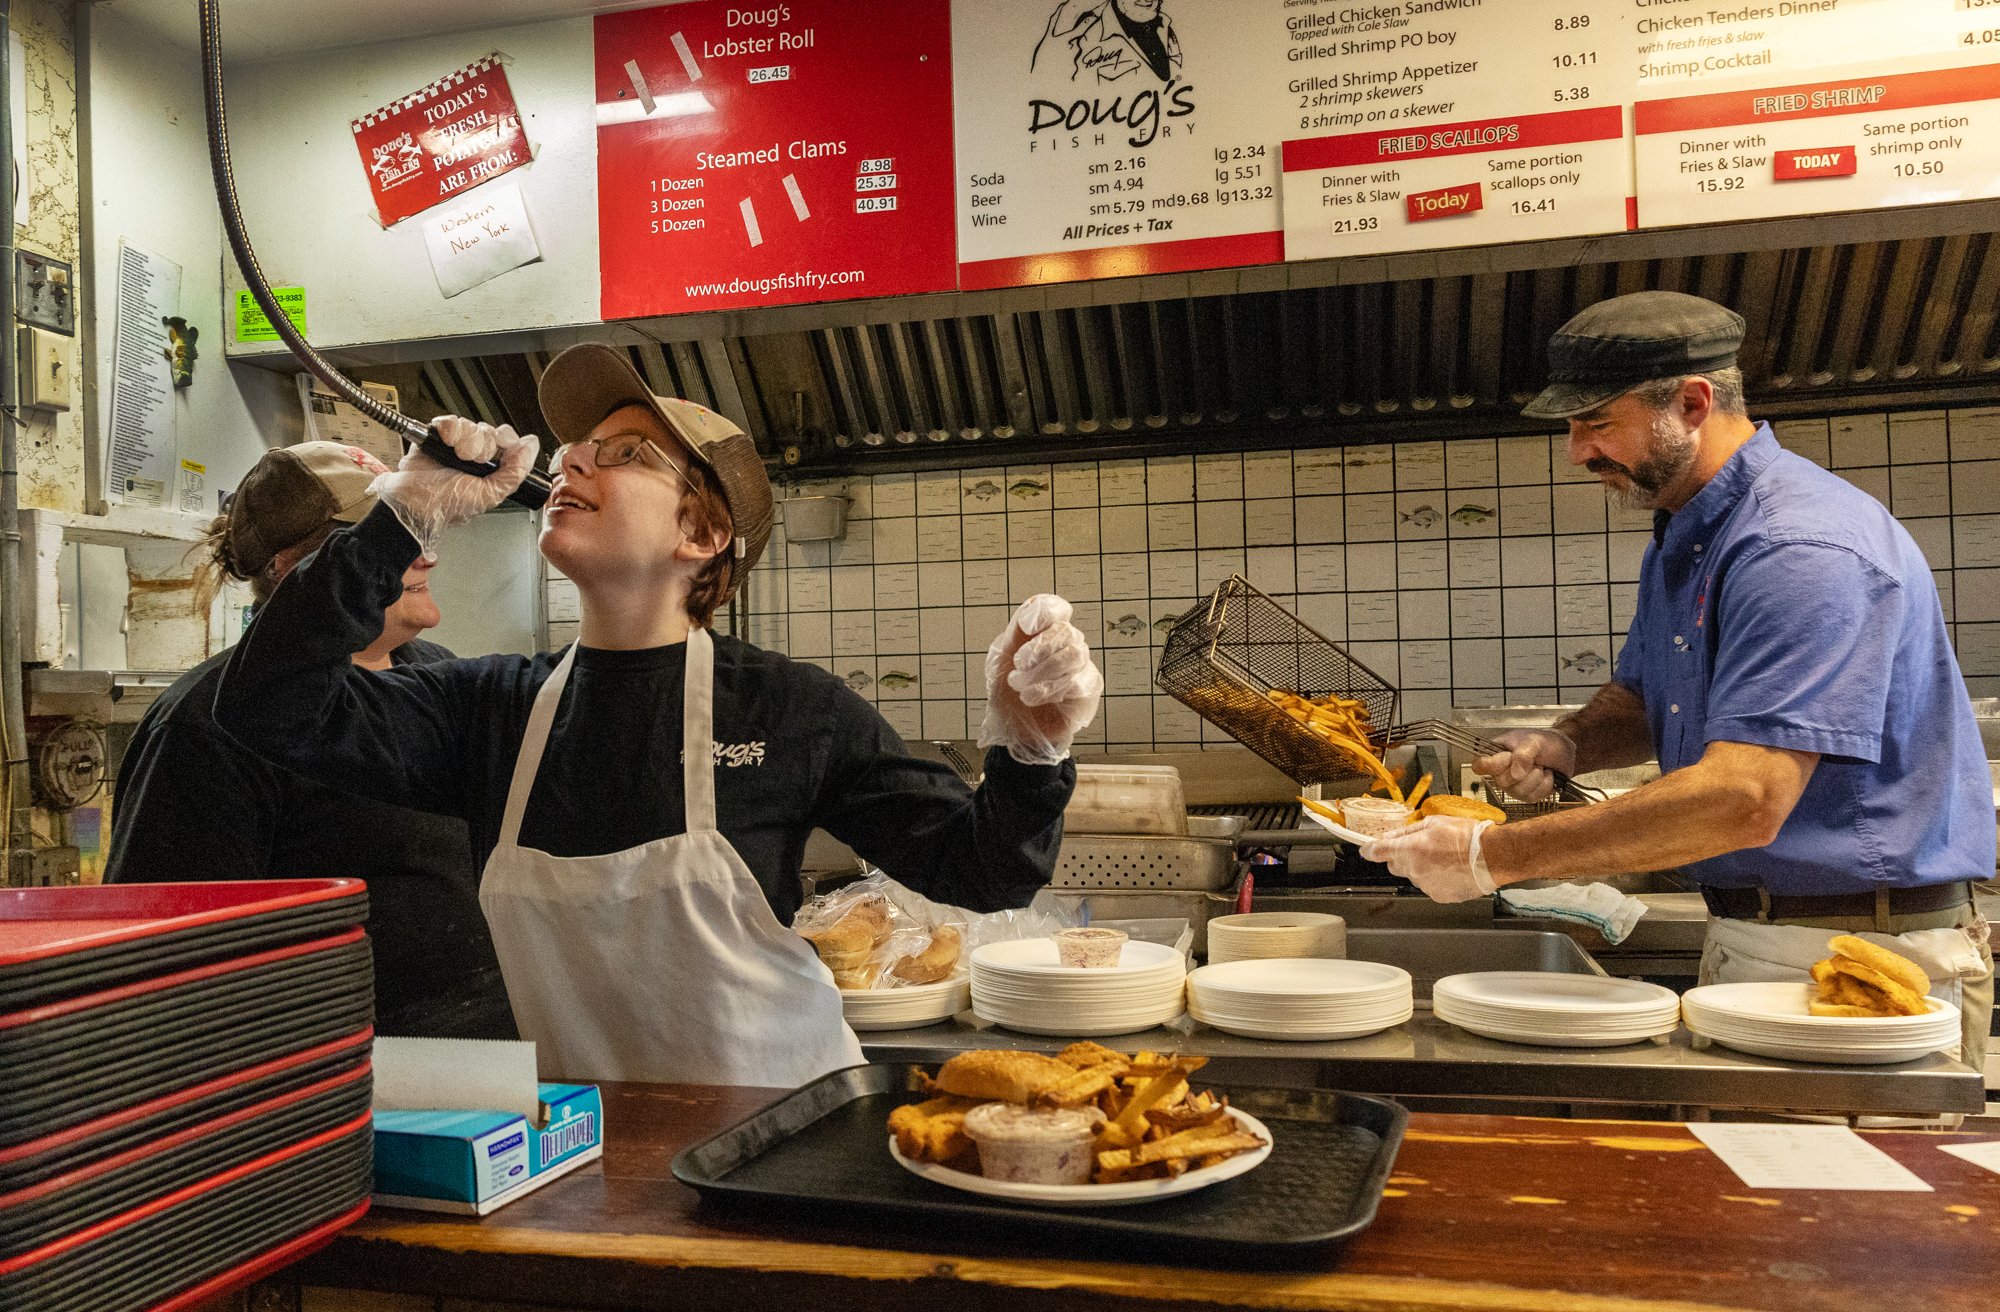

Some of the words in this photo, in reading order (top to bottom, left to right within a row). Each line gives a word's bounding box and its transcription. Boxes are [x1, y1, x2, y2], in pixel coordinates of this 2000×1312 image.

[726, 4, 791, 28] Doug's
[1286, 12, 1336, 31] Grilled
[1340, 6, 1401, 24] Chicken
[1405, 0, 1482, 15] Sandwich
[1554, 15, 1590, 32] 8.89
[1637, 15, 1704, 34] Chicken
[1707, 6, 1774, 25] Tenders
[1779, 0, 1838, 16] Dinner
[1290, 26, 1328, 42] Topped
[1332, 23, 1354, 34] with
[1358, 20, 1380, 32] Cole
[1383, 17, 1410, 29] Slaw
[1964, 29, 2000, 45] 4.05
[704, 34, 773, 58] Lobster
[780, 29, 815, 49] Roll
[1288, 43, 1337, 62] Grilled
[1342, 38, 1396, 56] Shrimp
[1401, 33, 1423, 48] PO
[1427, 31, 1457, 46] boy
[1638, 42, 1664, 54] with
[1666, 38, 1695, 50] fresh
[1698, 35, 1722, 49] fries
[1724, 32, 1734, 44] &
[1737, 31, 1765, 42] slaw
[1552, 51, 1598, 69] 10.11
[1639, 59, 1700, 79] Shrimp
[1704, 50, 1772, 71] Cocktail
[751, 66, 788, 82] 26.45
[1288, 74, 1338, 93] Grilled
[1342, 71, 1398, 86] Shrimp
[1402, 60, 1478, 82] Appetizer
[423, 83, 488, 124] TODAY'S
[1300, 96, 1308, 108] 2
[1312, 91, 1362, 107] shrimp
[1366, 84, 1424, 101] skewers
[1554, 86, 1590, 102] 5.38
[1754, 94, 1808, 116] FRIED
[1811, 86, 1886, 109] SHRIMP
[440, 110, 488, 139] FRESH
[1300, 116, 1310, 129] 8
[1312, 112, 1364, 128] shrimp
[1367, 110, 1386, 122] on
[1390, 108, 1399, 119] a
[1402, 100, 1454, 118] skewer
[1863, 122, 1906, 137] Same
[1910, 116, 1969, 136] portion
[1030, 134, 1105, 153] FISH
[1139, 122, 1196, 141] FRY
[1378, 134, 1428, 156] FRIED
[1430, 125, 1520, 149] SCALLOPS
[1680, 139, 1730, 155] Dinner
[1733, 134, 1766, 151] with
[1870, 141, 1924, 158] shrimp
[1928, 136, 1962, 153] only
[696, 144, 780, 170] Steamed
[788, 140, 847, 161] Clams
[1214, 148, 1228, 164] lg
[1232, 145, 1266, 160] 2.34
[1487, 158, 1527, 172] Same
[1530, 152, 1584, 170] portion
[1680, 158, 1715, 174] Fries
[1718, 156, 1728, 170] &
[1732, 154, 1766, 169] Slaw
[1792, 153, 1841, 170] TODAY
[439, 170, 468, 196] ARE
[468, 150, 519, 181] FROM:
[861, 159, 891, 172] 8.98
[1088, 162, 1109, 175] sm
[1114, 156, 1146, 172] 2.16
[1216, 168, 1229, 184] lg
[1234, 164, 1262, 180] 5.51
[1894, 160, 1944, 178] 10.50
[650, 180, 656, 192] 1
[662, 176, 704, 192] Dozen
[857, 175, 896, 190] 25.37
[970, 172, 1005, 188] Soda
[1089, 183, 1110, 195] sm
[1113, 177, 1144, 192] 4.94
[1322, 174, 1367, 189] Dinner
[1370, 170, 1400, 185] with
[1490, 176, 1548, 192] scallops
[1550, 172, 1580, 187] only
[1697, 176, 1746, 194] 15.92
[650, 200, 658, 214] 3
[662, 196, 704, 212] Dozen
[858, 197, 895, 212] 40.91
[972, 193, 1002, 208] Beer
[1322, 192, 1354, 208] Fries
[1356, 191, 1366, 204] &
[1368, 188, 1401, 203] Slaw
[1416, 190, 1470, 214] Today
[1511, 198, 1556, 214] 16.41
[440, 204, 495, 234] Western
[651, 220, 659, 234] 5
[662, 216, 705, 232] Dozen
[972, 213, 1007, 228] Wine
[1334, 216, 1378, 234] 21.93
[450, 236, 480, 254] New
[482, 222, 510, 239] York
[1062, 226, 1083, 241] All
[1086, 222, 1130, 238] Prices
[1134, 223, 1143, 232] +
[1147, 218, 1174, 232] Tax
[685, 270, 865, 297] www.dougsfishfry.com
[276, 294, 302, 302] 23-9383
